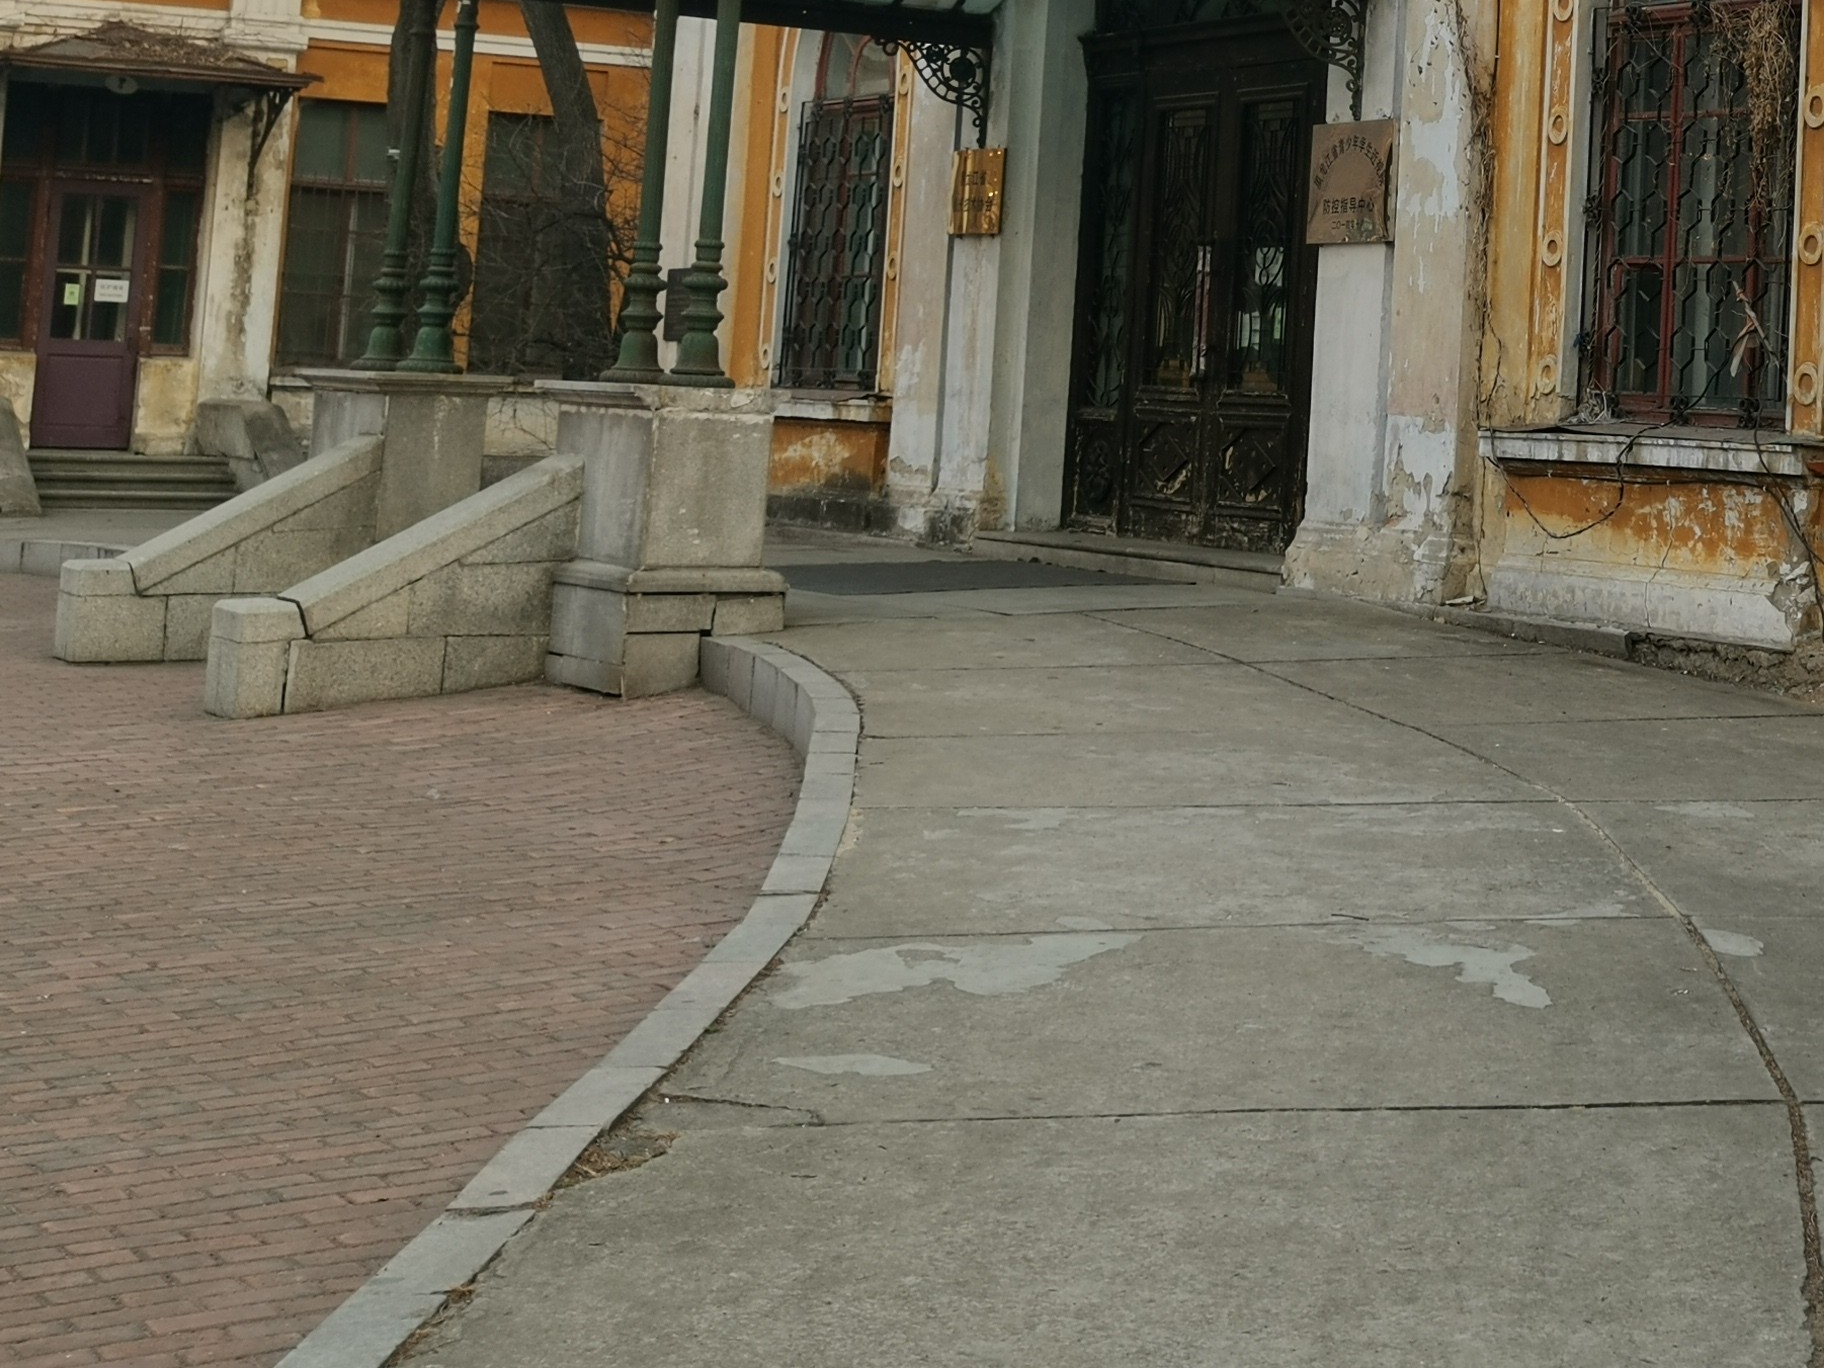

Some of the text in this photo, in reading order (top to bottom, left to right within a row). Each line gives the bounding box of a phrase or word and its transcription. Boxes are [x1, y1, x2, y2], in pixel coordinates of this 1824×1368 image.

[1322, 196, 1375, 215] 防控指导中心
